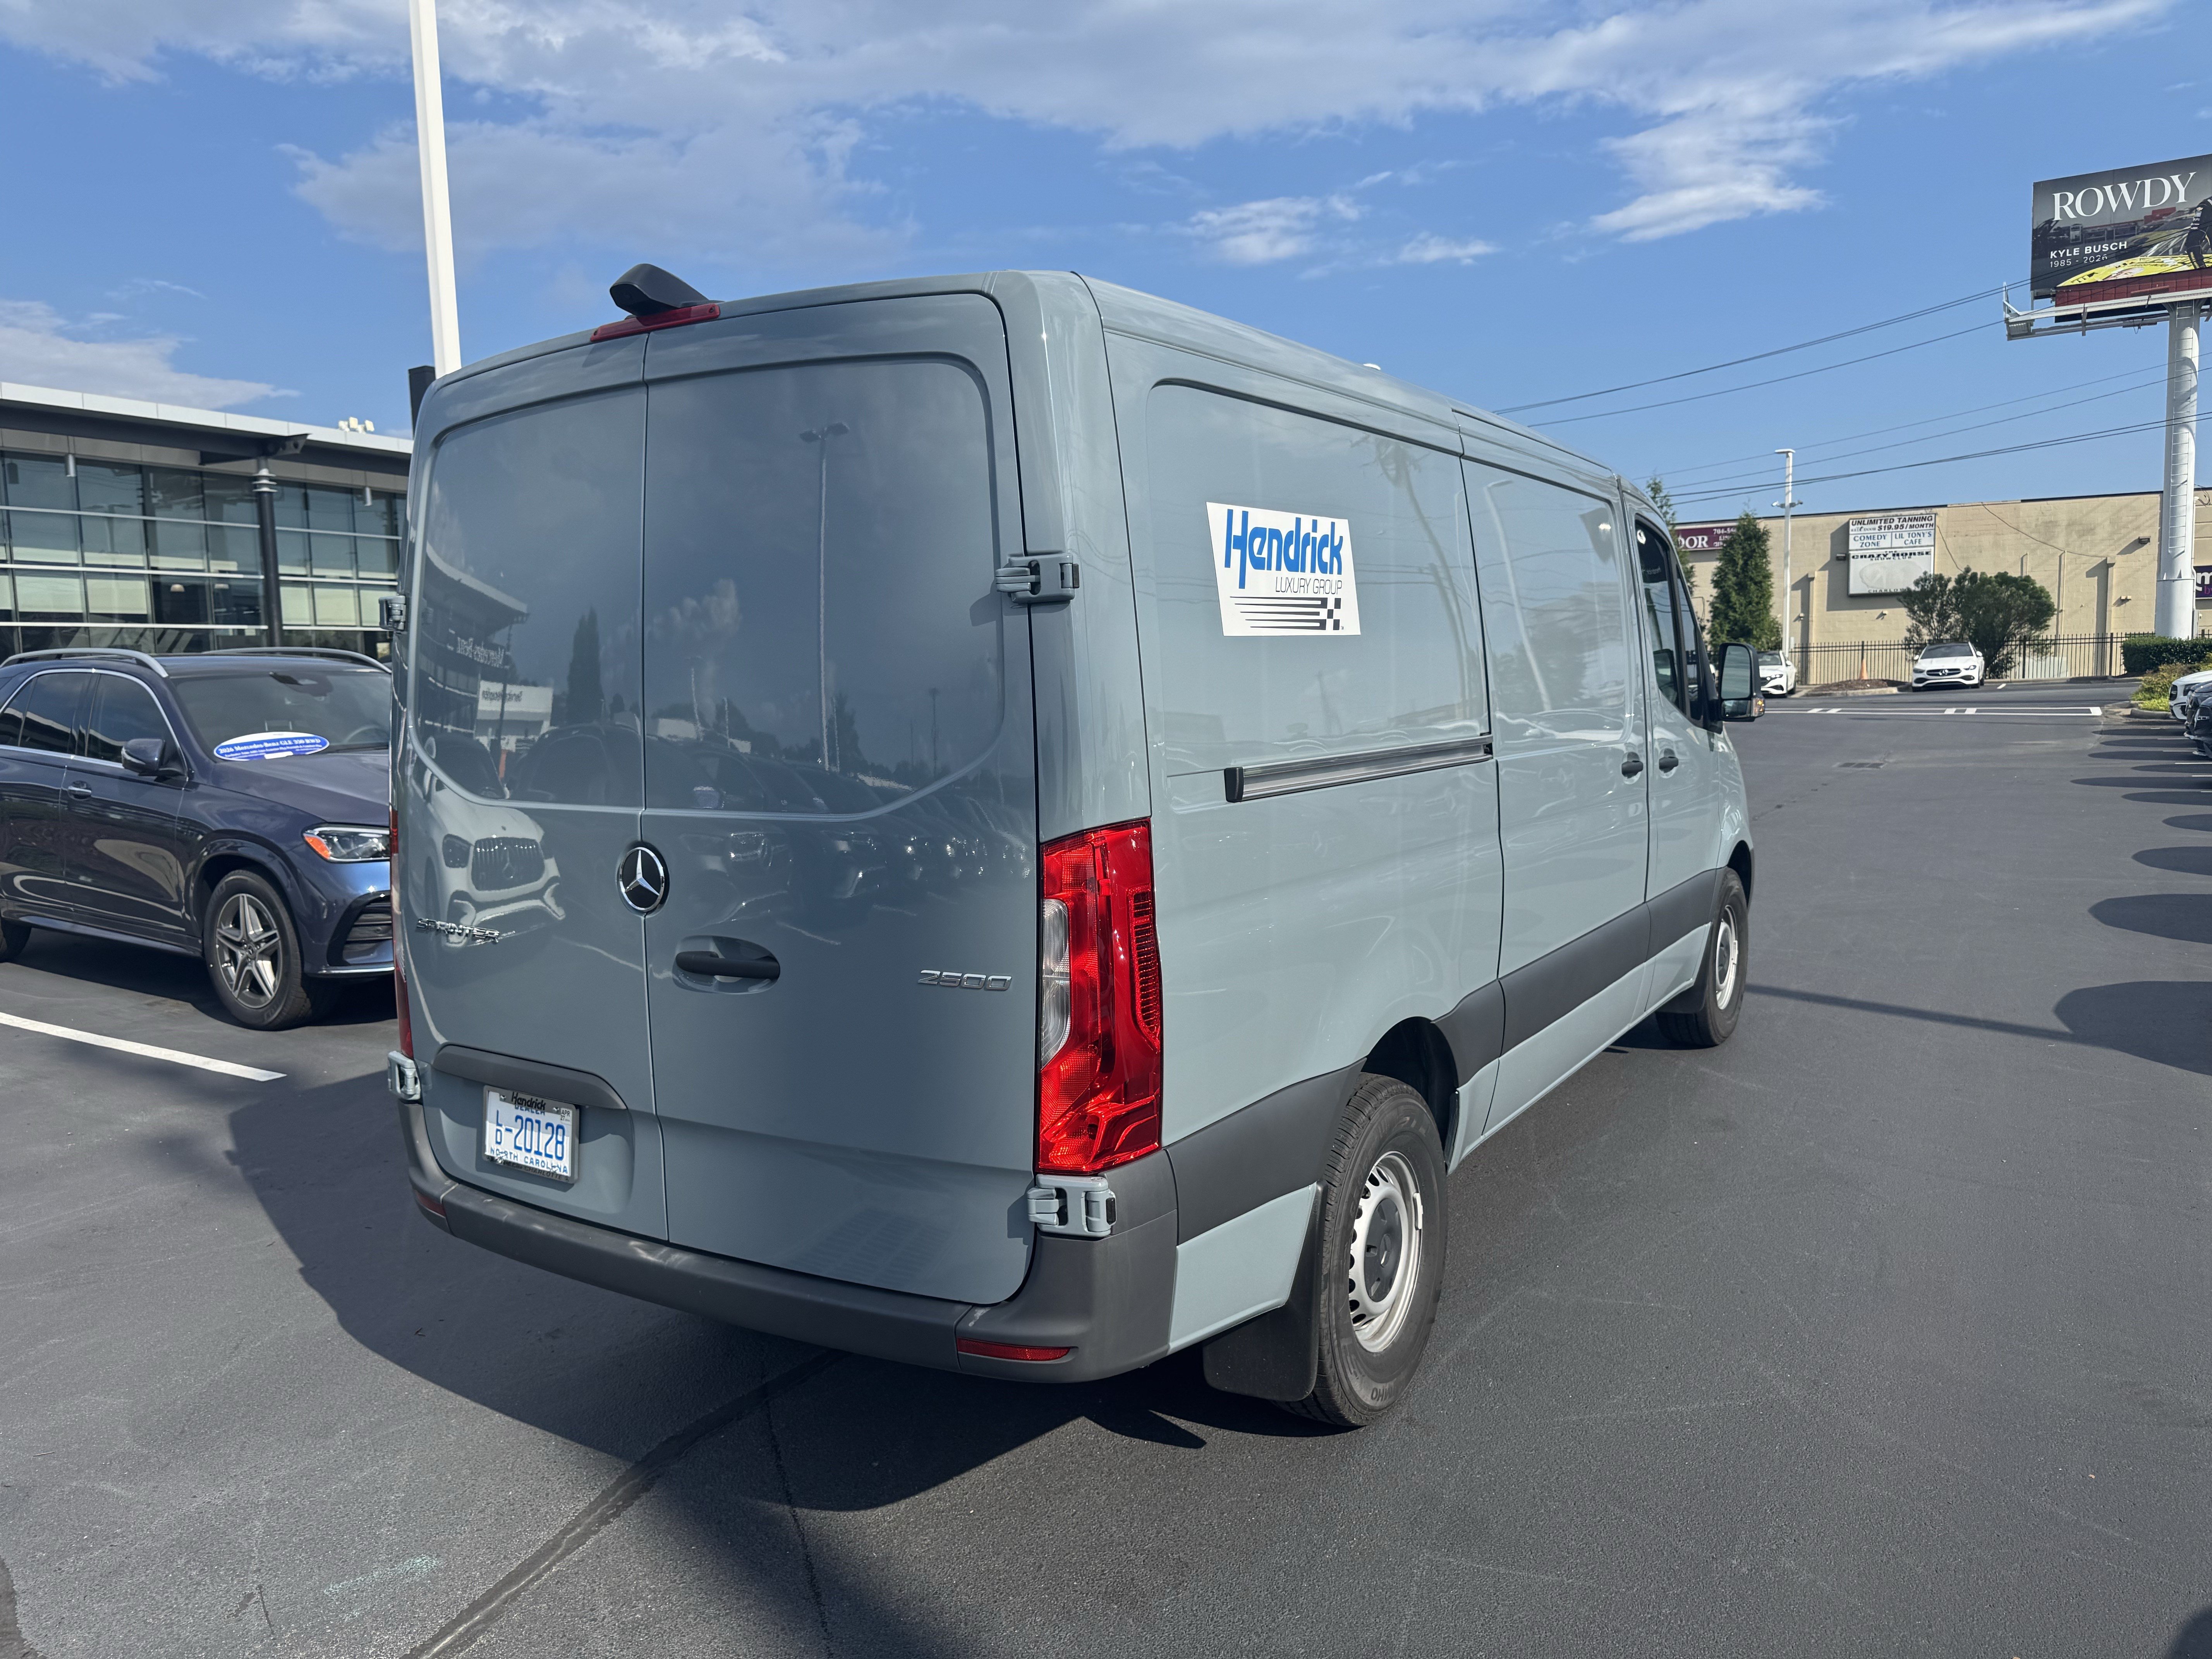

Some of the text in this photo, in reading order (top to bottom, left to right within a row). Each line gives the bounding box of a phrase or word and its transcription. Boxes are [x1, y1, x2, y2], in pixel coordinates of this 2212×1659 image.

[2052, 172, 2197, 221] ROWDY
[2050, 241, 2127, 259] KYLE BUSCH
[2050, 259, 2071, 268] 1985
[2083, 254, 2107, 263] 2026
[1224, 509, 1343, 589] Hendrick
[1276, 576, 1342, 595] LUXURY GROUP
[918, 970, 1012, 991] 2500
[512, 1091, 546, 1111] Hendrick
[562, 1109, 570, 1117] APR
[490, 1146, 518, 1161] NORTH
[524, 1156, 568, 1174] CAROLINA
[524, 1166, 562, 1180] CHARLOTTE
